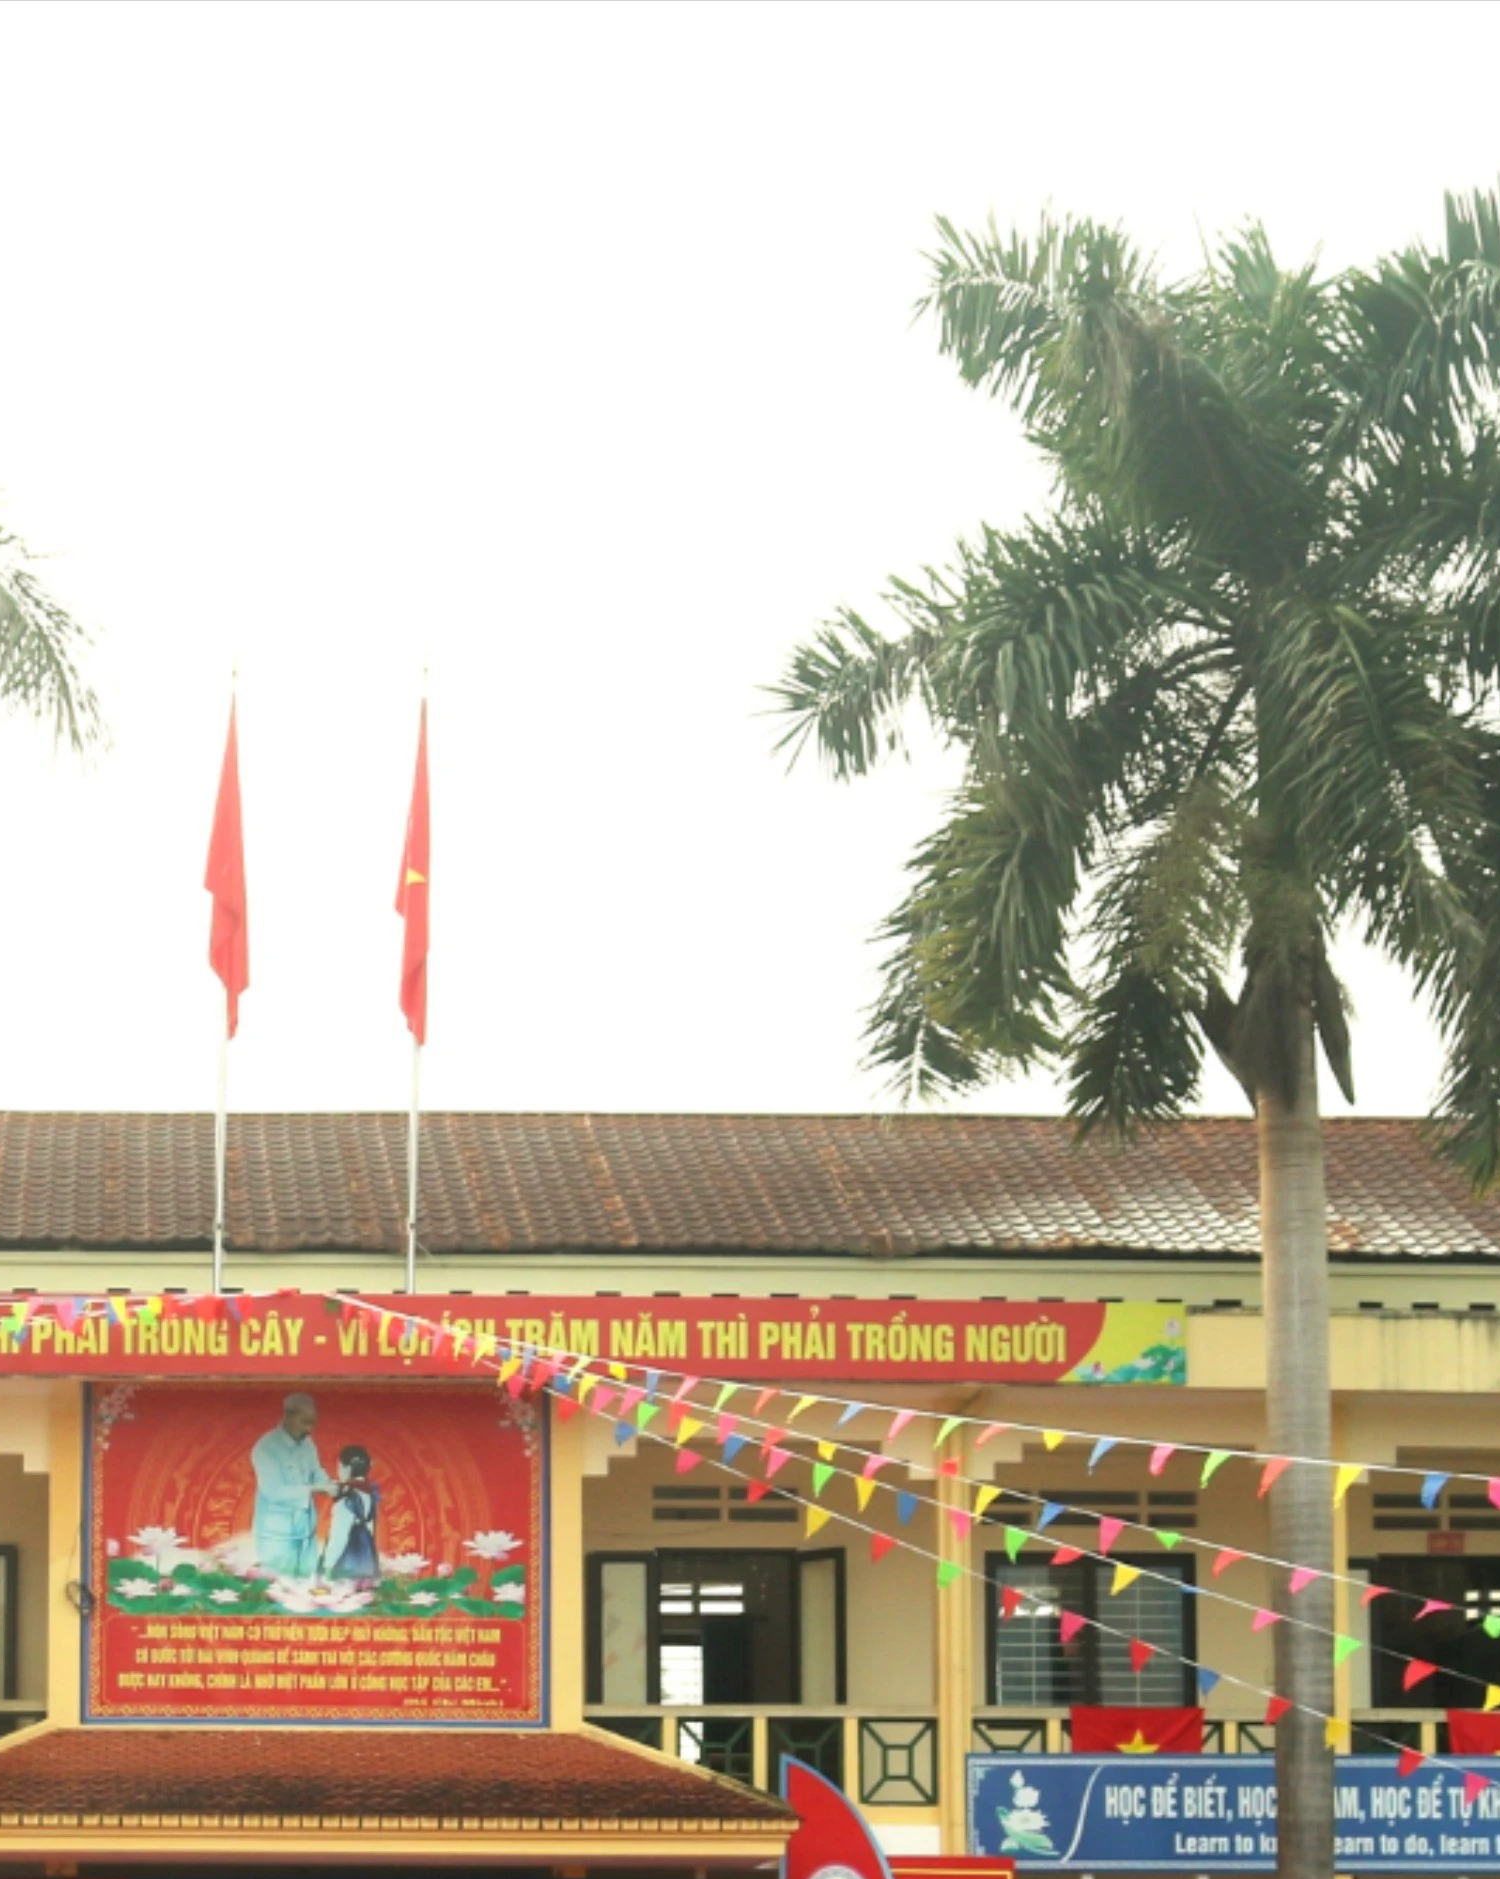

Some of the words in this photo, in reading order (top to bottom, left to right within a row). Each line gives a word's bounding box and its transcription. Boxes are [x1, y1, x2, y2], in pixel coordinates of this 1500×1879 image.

[240, 1309, 304, 1356] CÂY
[505, 1311, 600, 1358] TRĂM
[611, 1311, 689, 1359] NĂM
[697, 1312, 750, 1360] THÌ
[758, 1305, 837, 1361] PHẢI
[846, 1310, 955, 1362] TRỒNG
[964, 1315, 1066, 1363] NGƯỜI
[1105, 1785, 1146, 1825] HỌC
[1151, 1773, 1178, 1818] ĐỂ
[1184, 1775, 1233, 1822] BIẾT,
[1238, 1786, 1278, 1826] HỌC
[1371, 1786, 1412, 1827] HỌC
[1417, 1774, 1443, 1819] ĐỂ
[1176, 1833, 1229, 1854] Learn
[1235, 1834, 1254, 1854] to
[1334, 1836, 1375, 1855] earn
[1380, 1834, 1399, 1855] to
[1404, 1834, 1434, 1857] do,
[1440, 1834, 1489, 1855] learn
